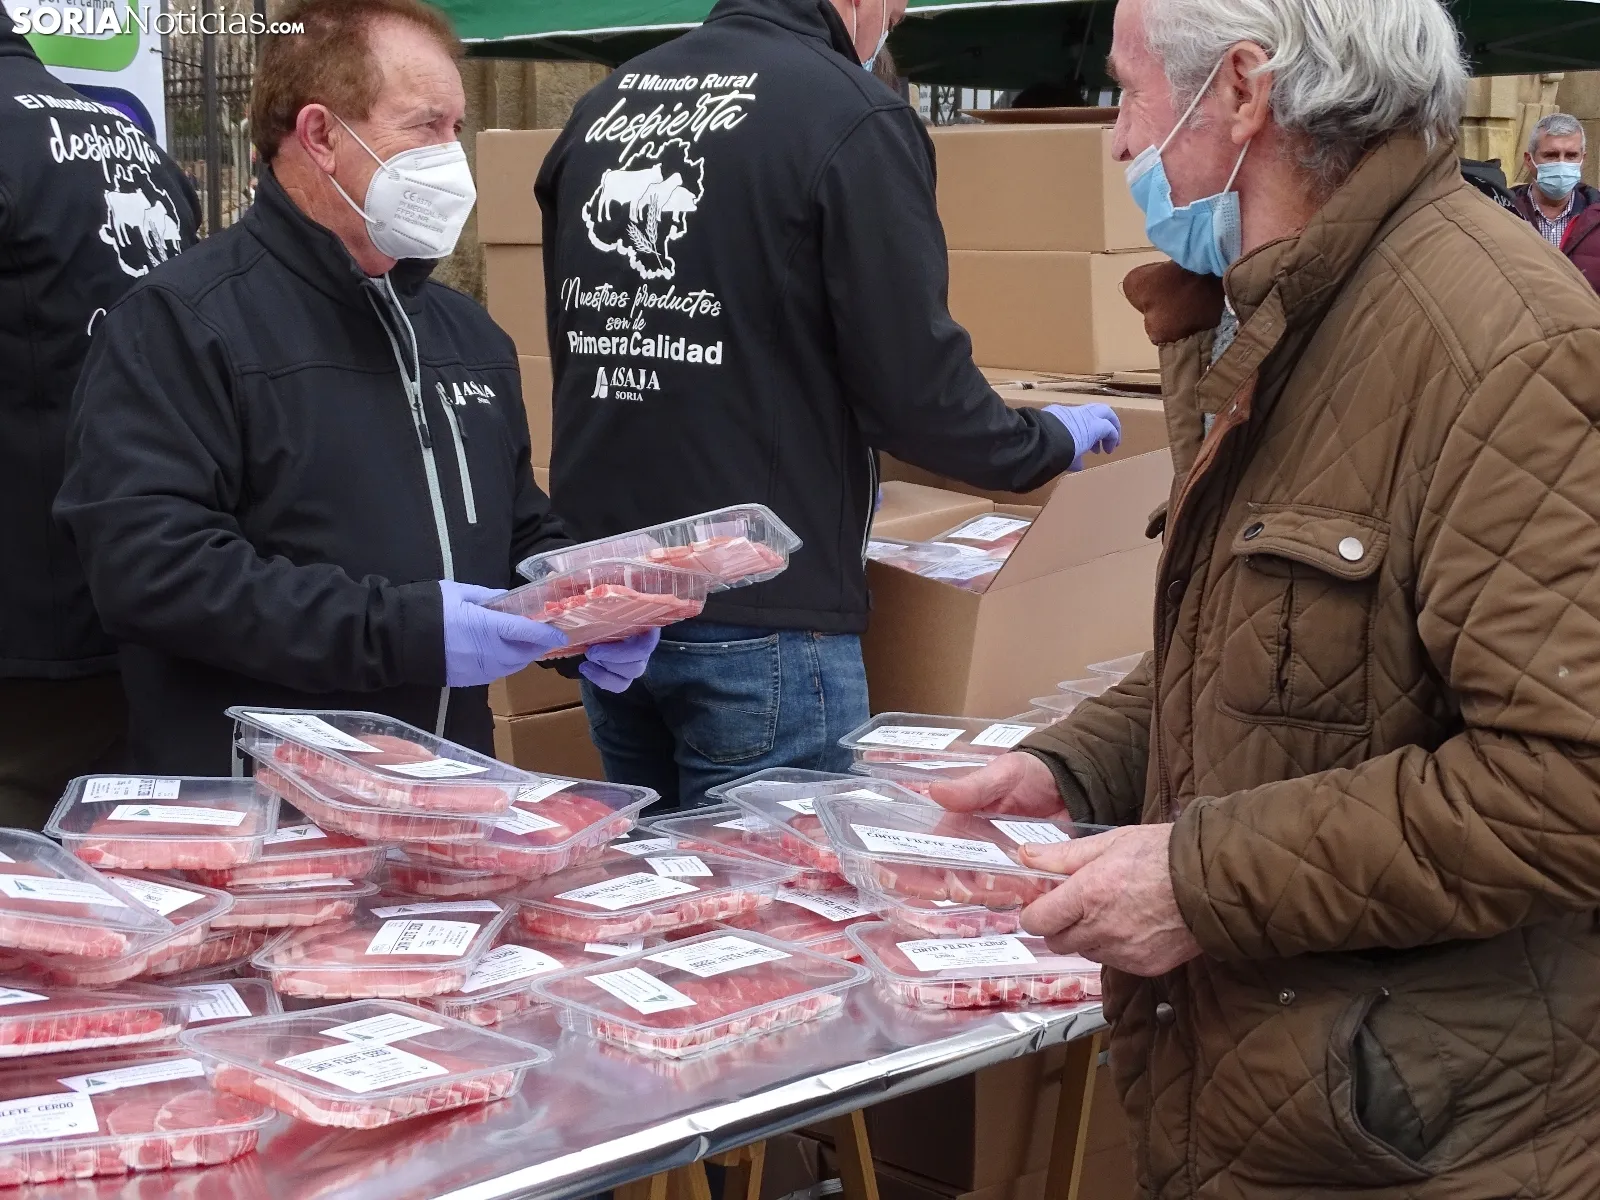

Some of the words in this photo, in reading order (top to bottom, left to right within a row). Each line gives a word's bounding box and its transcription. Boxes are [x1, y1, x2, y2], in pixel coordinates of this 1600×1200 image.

[618, 73, 640, 89] El
[637, 74, 698, 91] Mundo
[700, 73, 758, 89] Rural
[14, 94, 44, 109] El
[37, 94, 99, 113] Mundo
[585, 90, 756, 163] despierta
[50, 117, 161, 183] despierta
[560, 276, 630, 312] Nuestros
[630, 284, 722, 318] productos
[606, 316, 631, 331] son
[632, 310, 646, 331] de
[615, 391, 644, 401] SORIA
[0, 1107, 30, 1118] LETE
[38, 1101, 74, 1112] CERDO
